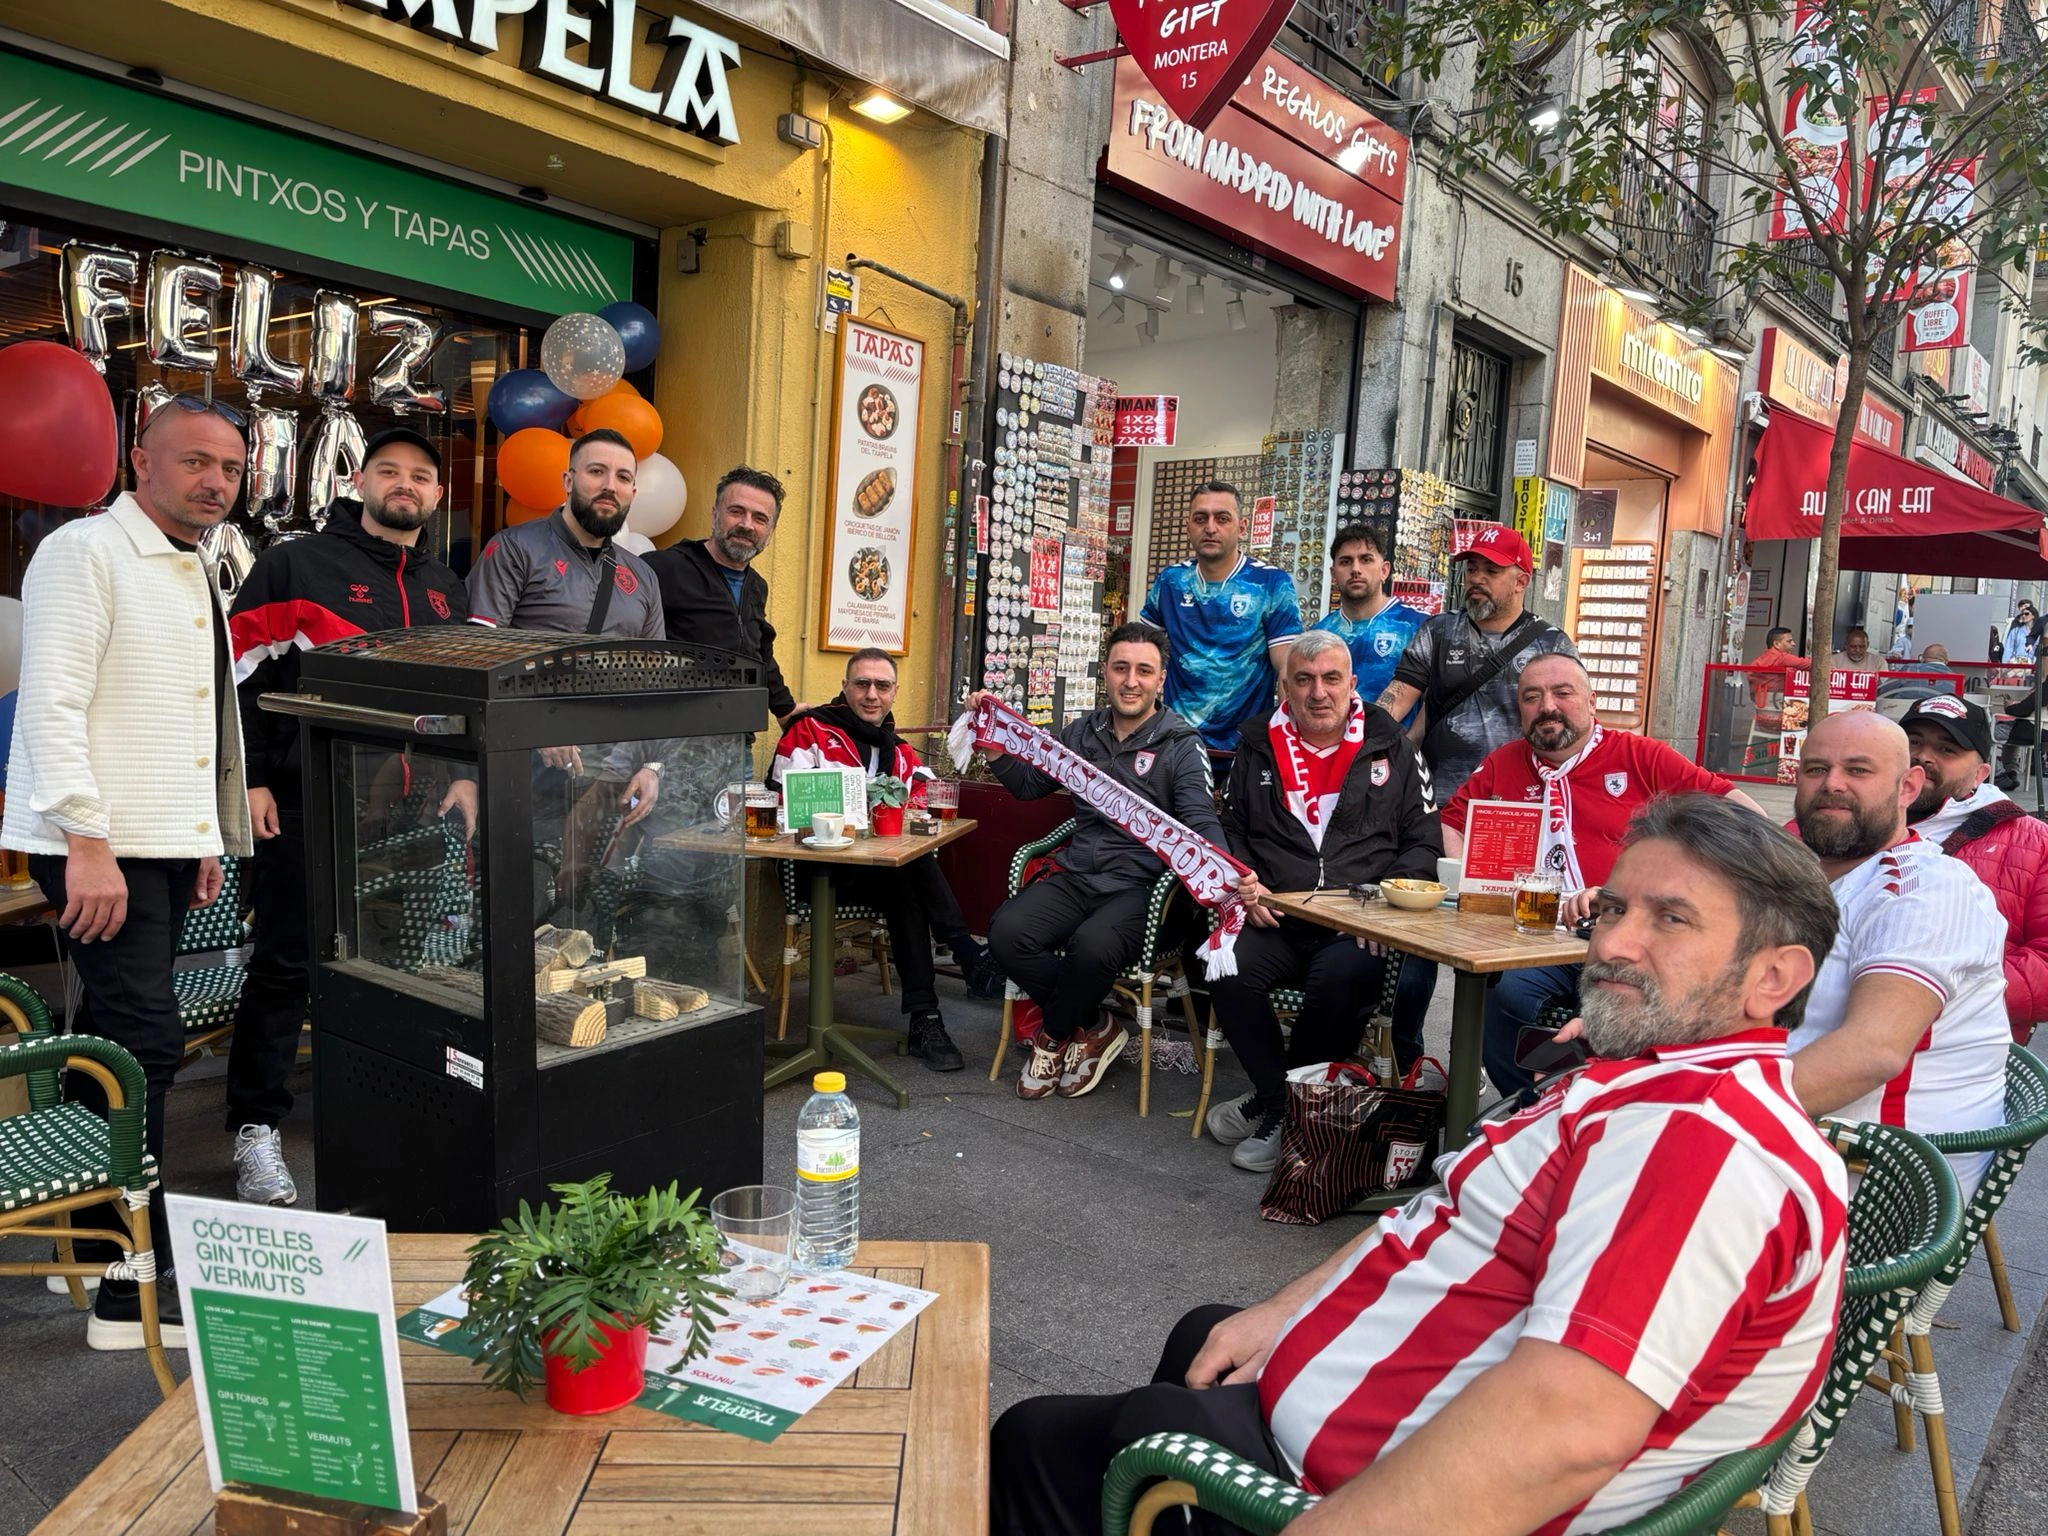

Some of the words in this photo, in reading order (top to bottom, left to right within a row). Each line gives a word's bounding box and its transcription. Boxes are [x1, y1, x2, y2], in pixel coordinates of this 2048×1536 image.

[1160, 0, 1226, 38] GIFT
[1154, 39, 1229, 70] MONTERA
[1181, 72, 1198, 89] 15
[1262, 65, 1345, 144] REGALOS
[1129, 98, 1205, 171] FROM
[1204, 138, 1294, 212] MADRID
[1292, 181, 1344, 243] WITH
[179, 149, 347, 222] PINTXOS
[355, 196, 379, 230] Y
[386, 206, 491, 261] TAPAS
[1504, 257, 1524, 297] 15
[60, 238, 449, 414] FELIZ
[1924, 309, 1949, 318] BUFFET
[1924, 318, 1943, 327] LIBRE
[853, 328, 914, 367] TAPAS
[1621, 332, 1704, 406] miramira
[1925, 414, 1959, 466] MADRID
[1549, 489, 1568, 520] HR
[1855, 488, 1891, 515] CAN
[1898, 487, 1935, 513] EAT
[1583, 531, 1602, 542] 3+1
[1850, 673, 1872, 689] EAT
[1004, 720, 1227, 901] SAMSUNSPOR
[1394, 1148, 1420, 1156] STORE
[192, 1217, 314, 1252] CÓCTELES
[195, 1242, 234, 1264] GIN
[241, 1247, 323, 1276] TONICS
[198, 1264, 306, 1296] VERMUTS
[689, 1369, 736, 1386] PINTXOS
[217, 1390, 234, 1400] GIN
[235, 1393, 270, 1407] TONICS
[692, 1394, 777, 1427] TXAPELA
[306, 1432, 352, 1447] VERMUTS
